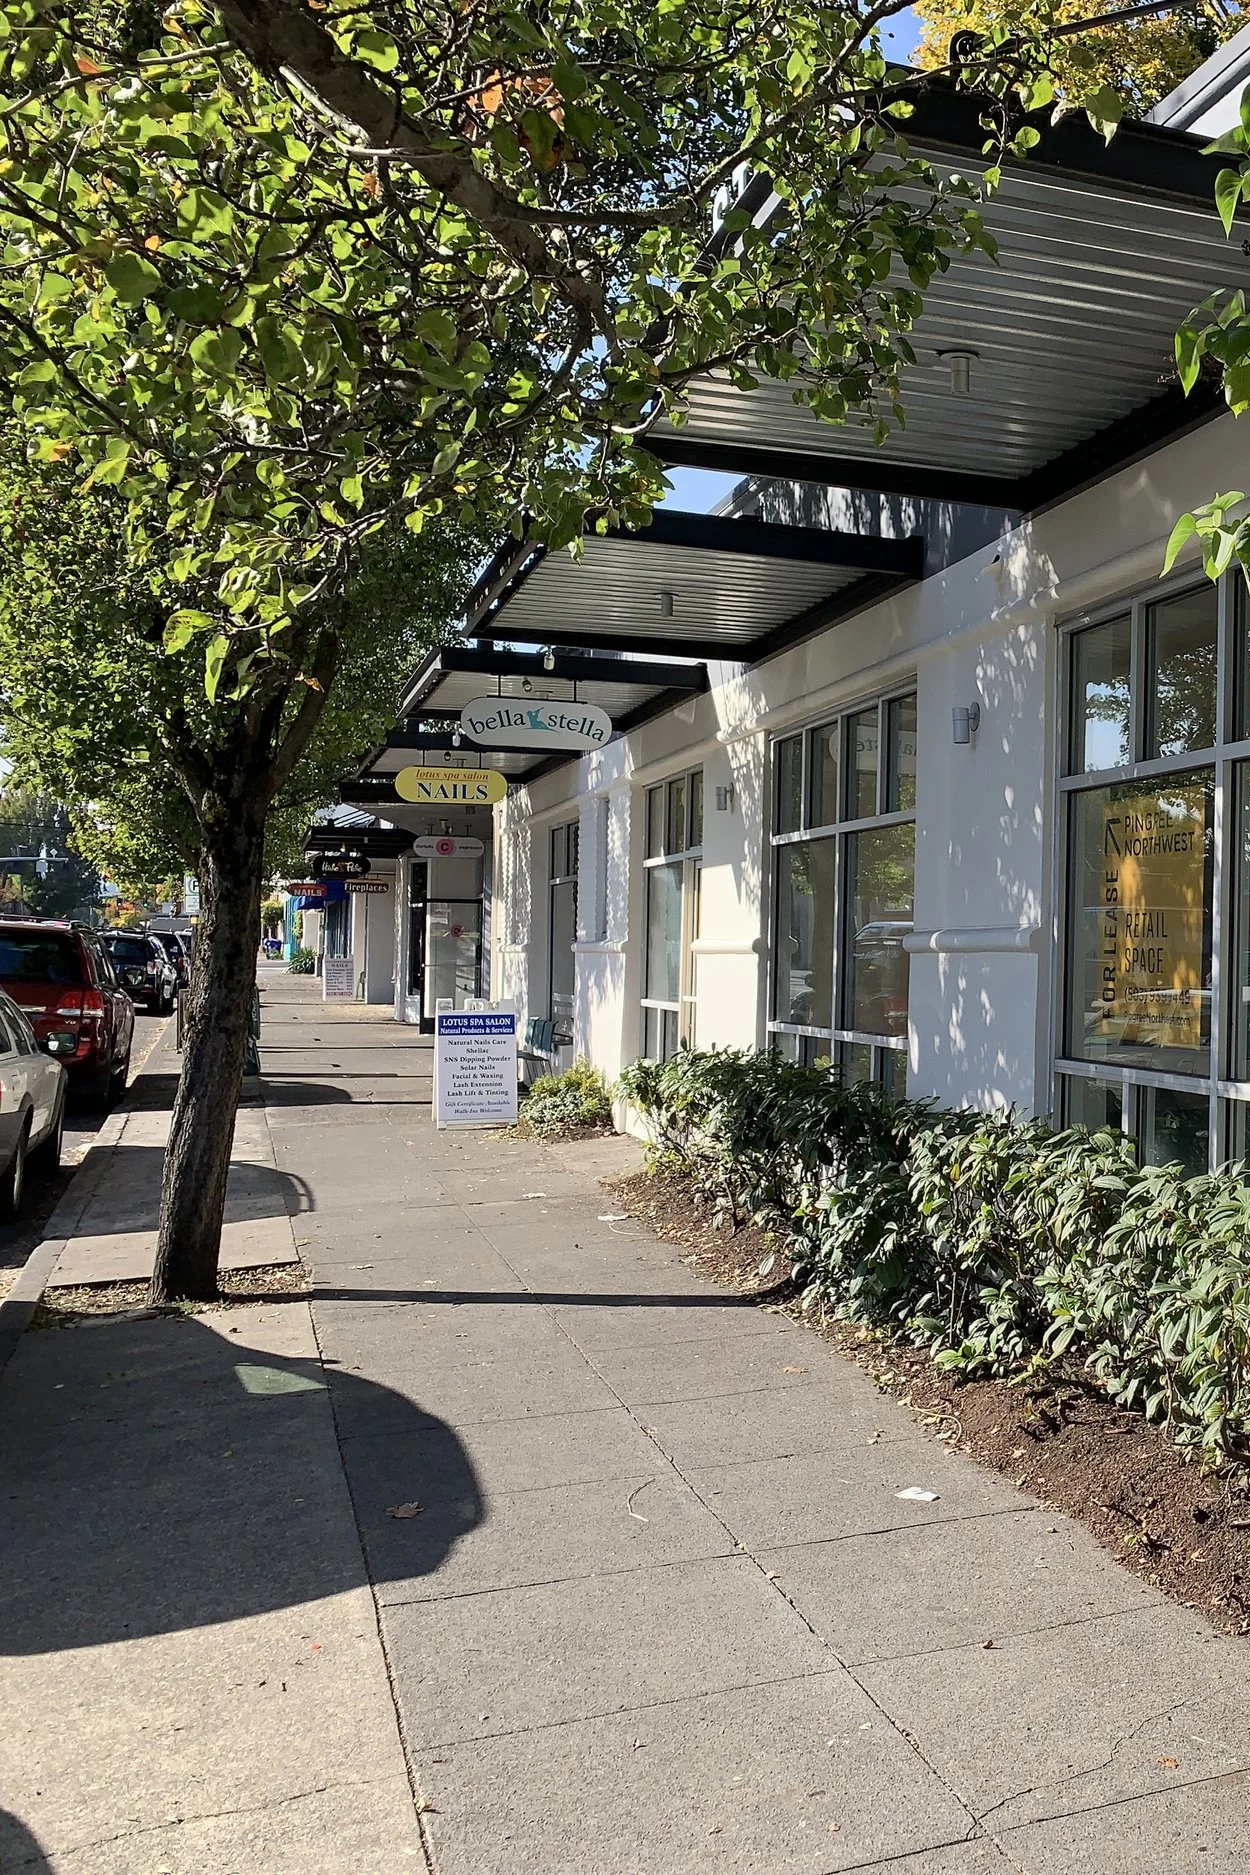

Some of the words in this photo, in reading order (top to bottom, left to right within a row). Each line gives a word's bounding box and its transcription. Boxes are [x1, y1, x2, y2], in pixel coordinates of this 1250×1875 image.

[467, 708, 526, 734] bella
[548, 713, 604, 742] stella
[416, 769, 440, 778] lotus
[443, 772, 460, 781] spa
[463, 771, 489, 780] salon
[417, 782, 488, 800] NAILS
[1124, 810, 1173, 834] PINGREE
[1124, 831, 1195, 857] NORTHWEST
[293, 888, 322, 897] NAILS
[344, 882, 388, 893] Fireplaces
[1104, 869, 1119, 955] LEASE
[1125, 911, 1168, 938] RETAIL
[1124, 947, 1164, 974] SPACE
[1102, 966, 1116, 1019] FOR
[442, 1018, 468, 1026] LOTUS
[470, 1018, 484, 1026] SPA
[486, 1018, 510, 1026] SALON
[492, 1026, 513, 1034] Services
